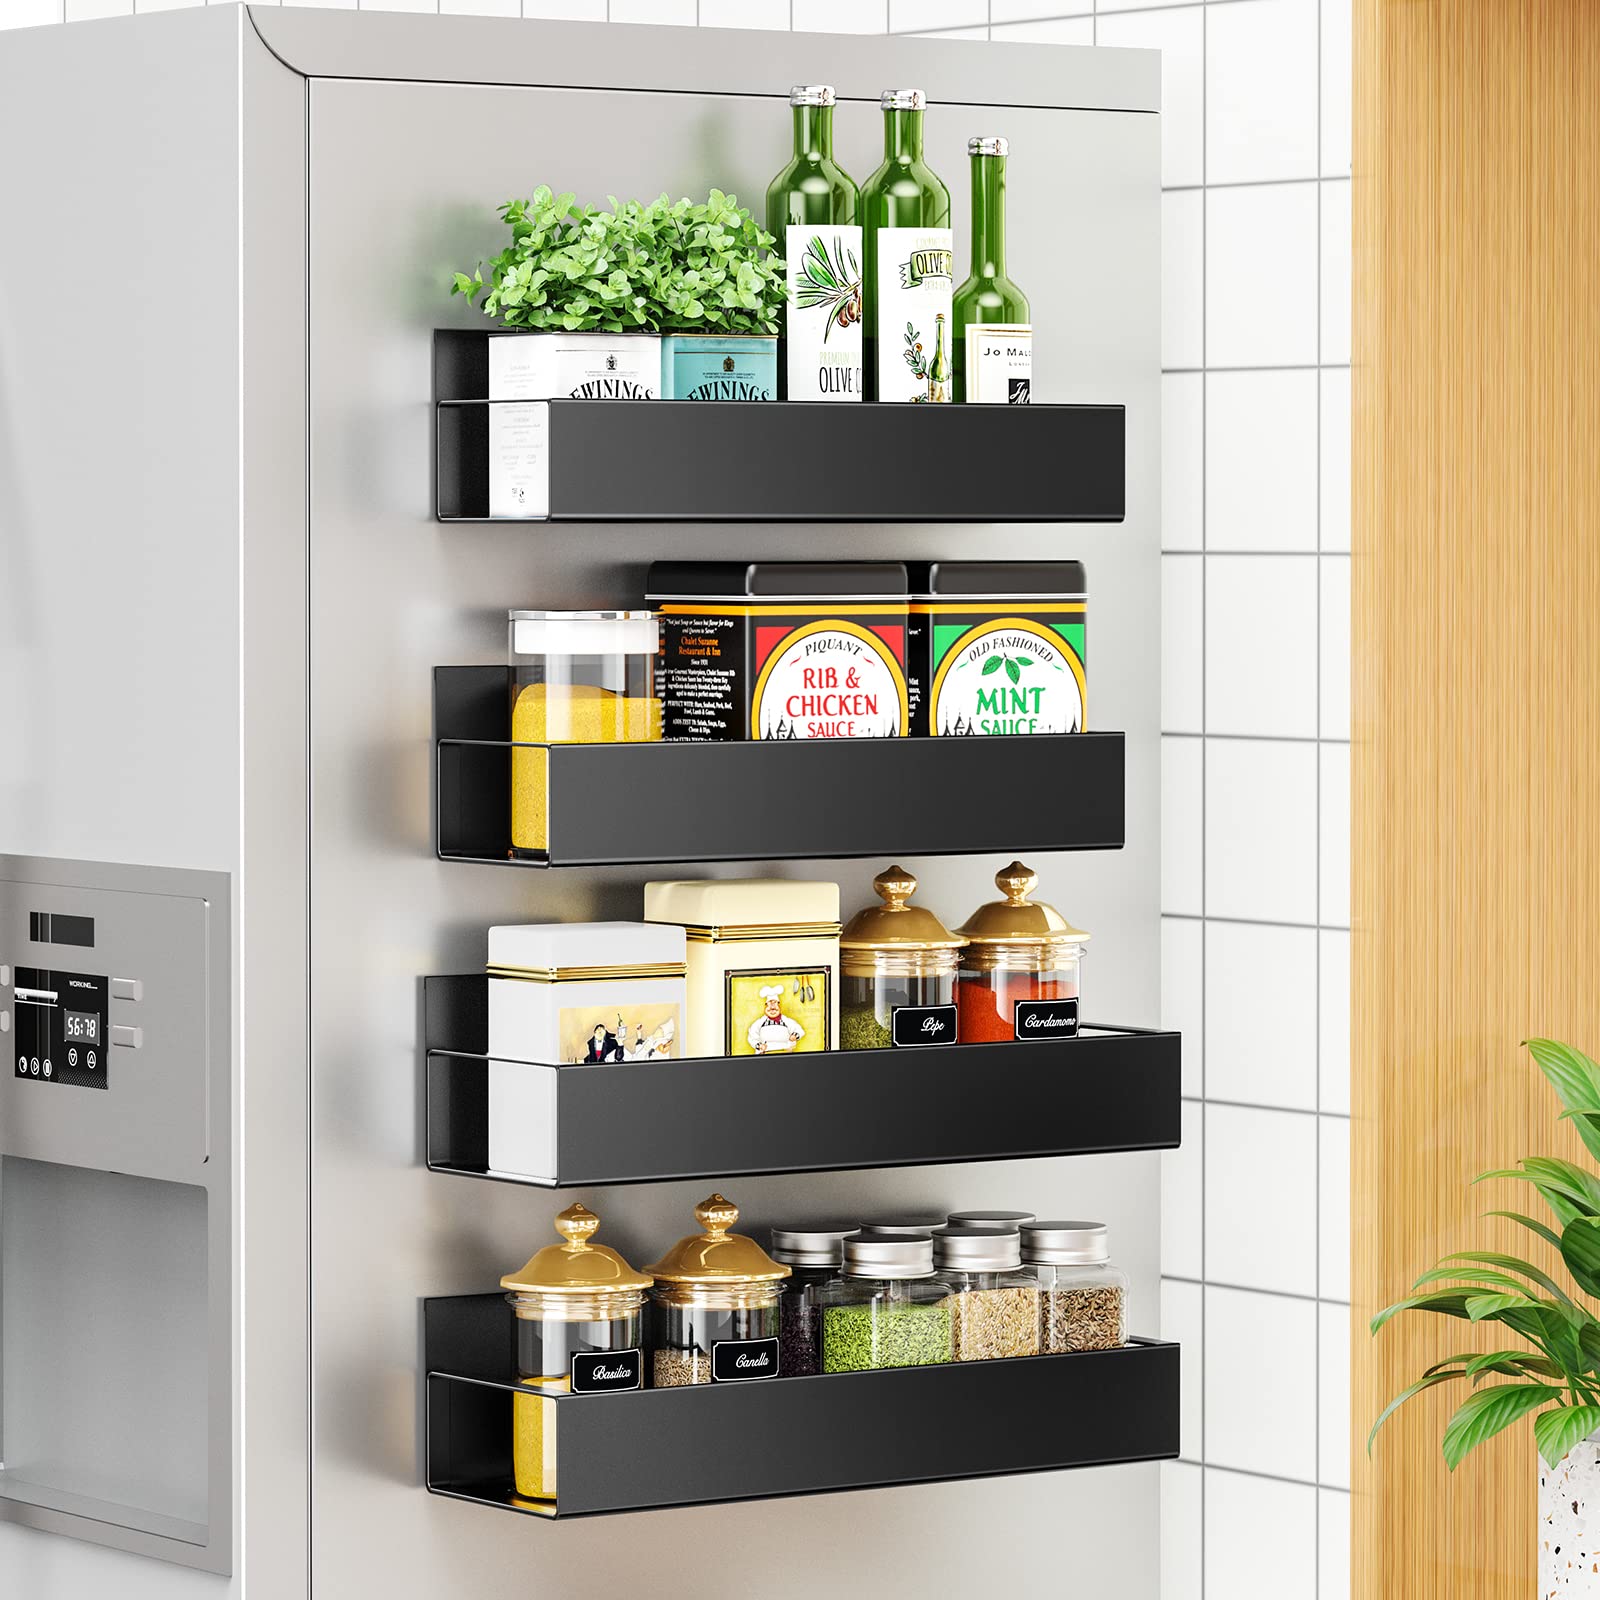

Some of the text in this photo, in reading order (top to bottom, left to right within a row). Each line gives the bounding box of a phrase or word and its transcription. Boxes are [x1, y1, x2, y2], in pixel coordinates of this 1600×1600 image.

[916, 253, 943, 275] OLIVE
[819, 351, 850, 366] PREMIUM
[819, 367, 852, 393] OLIVE
[678, 646, 721, 656] Restaurant & Inn
[805, 638, 863, 656] PIQUANT
[969, 636, 1054, 663] OLD FASHIONED
[803, 667, 861, 689] RIB &
[786, 694, 879, 717] CHICKEN
[976, 687, 1046, 715] MINT
[807, 721, 857, 738] SAUCE
[980, 719, 1038, 736] SAUCE
[67, 1016, 96, 1038] 56:78
[920, 1017, 945, 1036] Pepe
